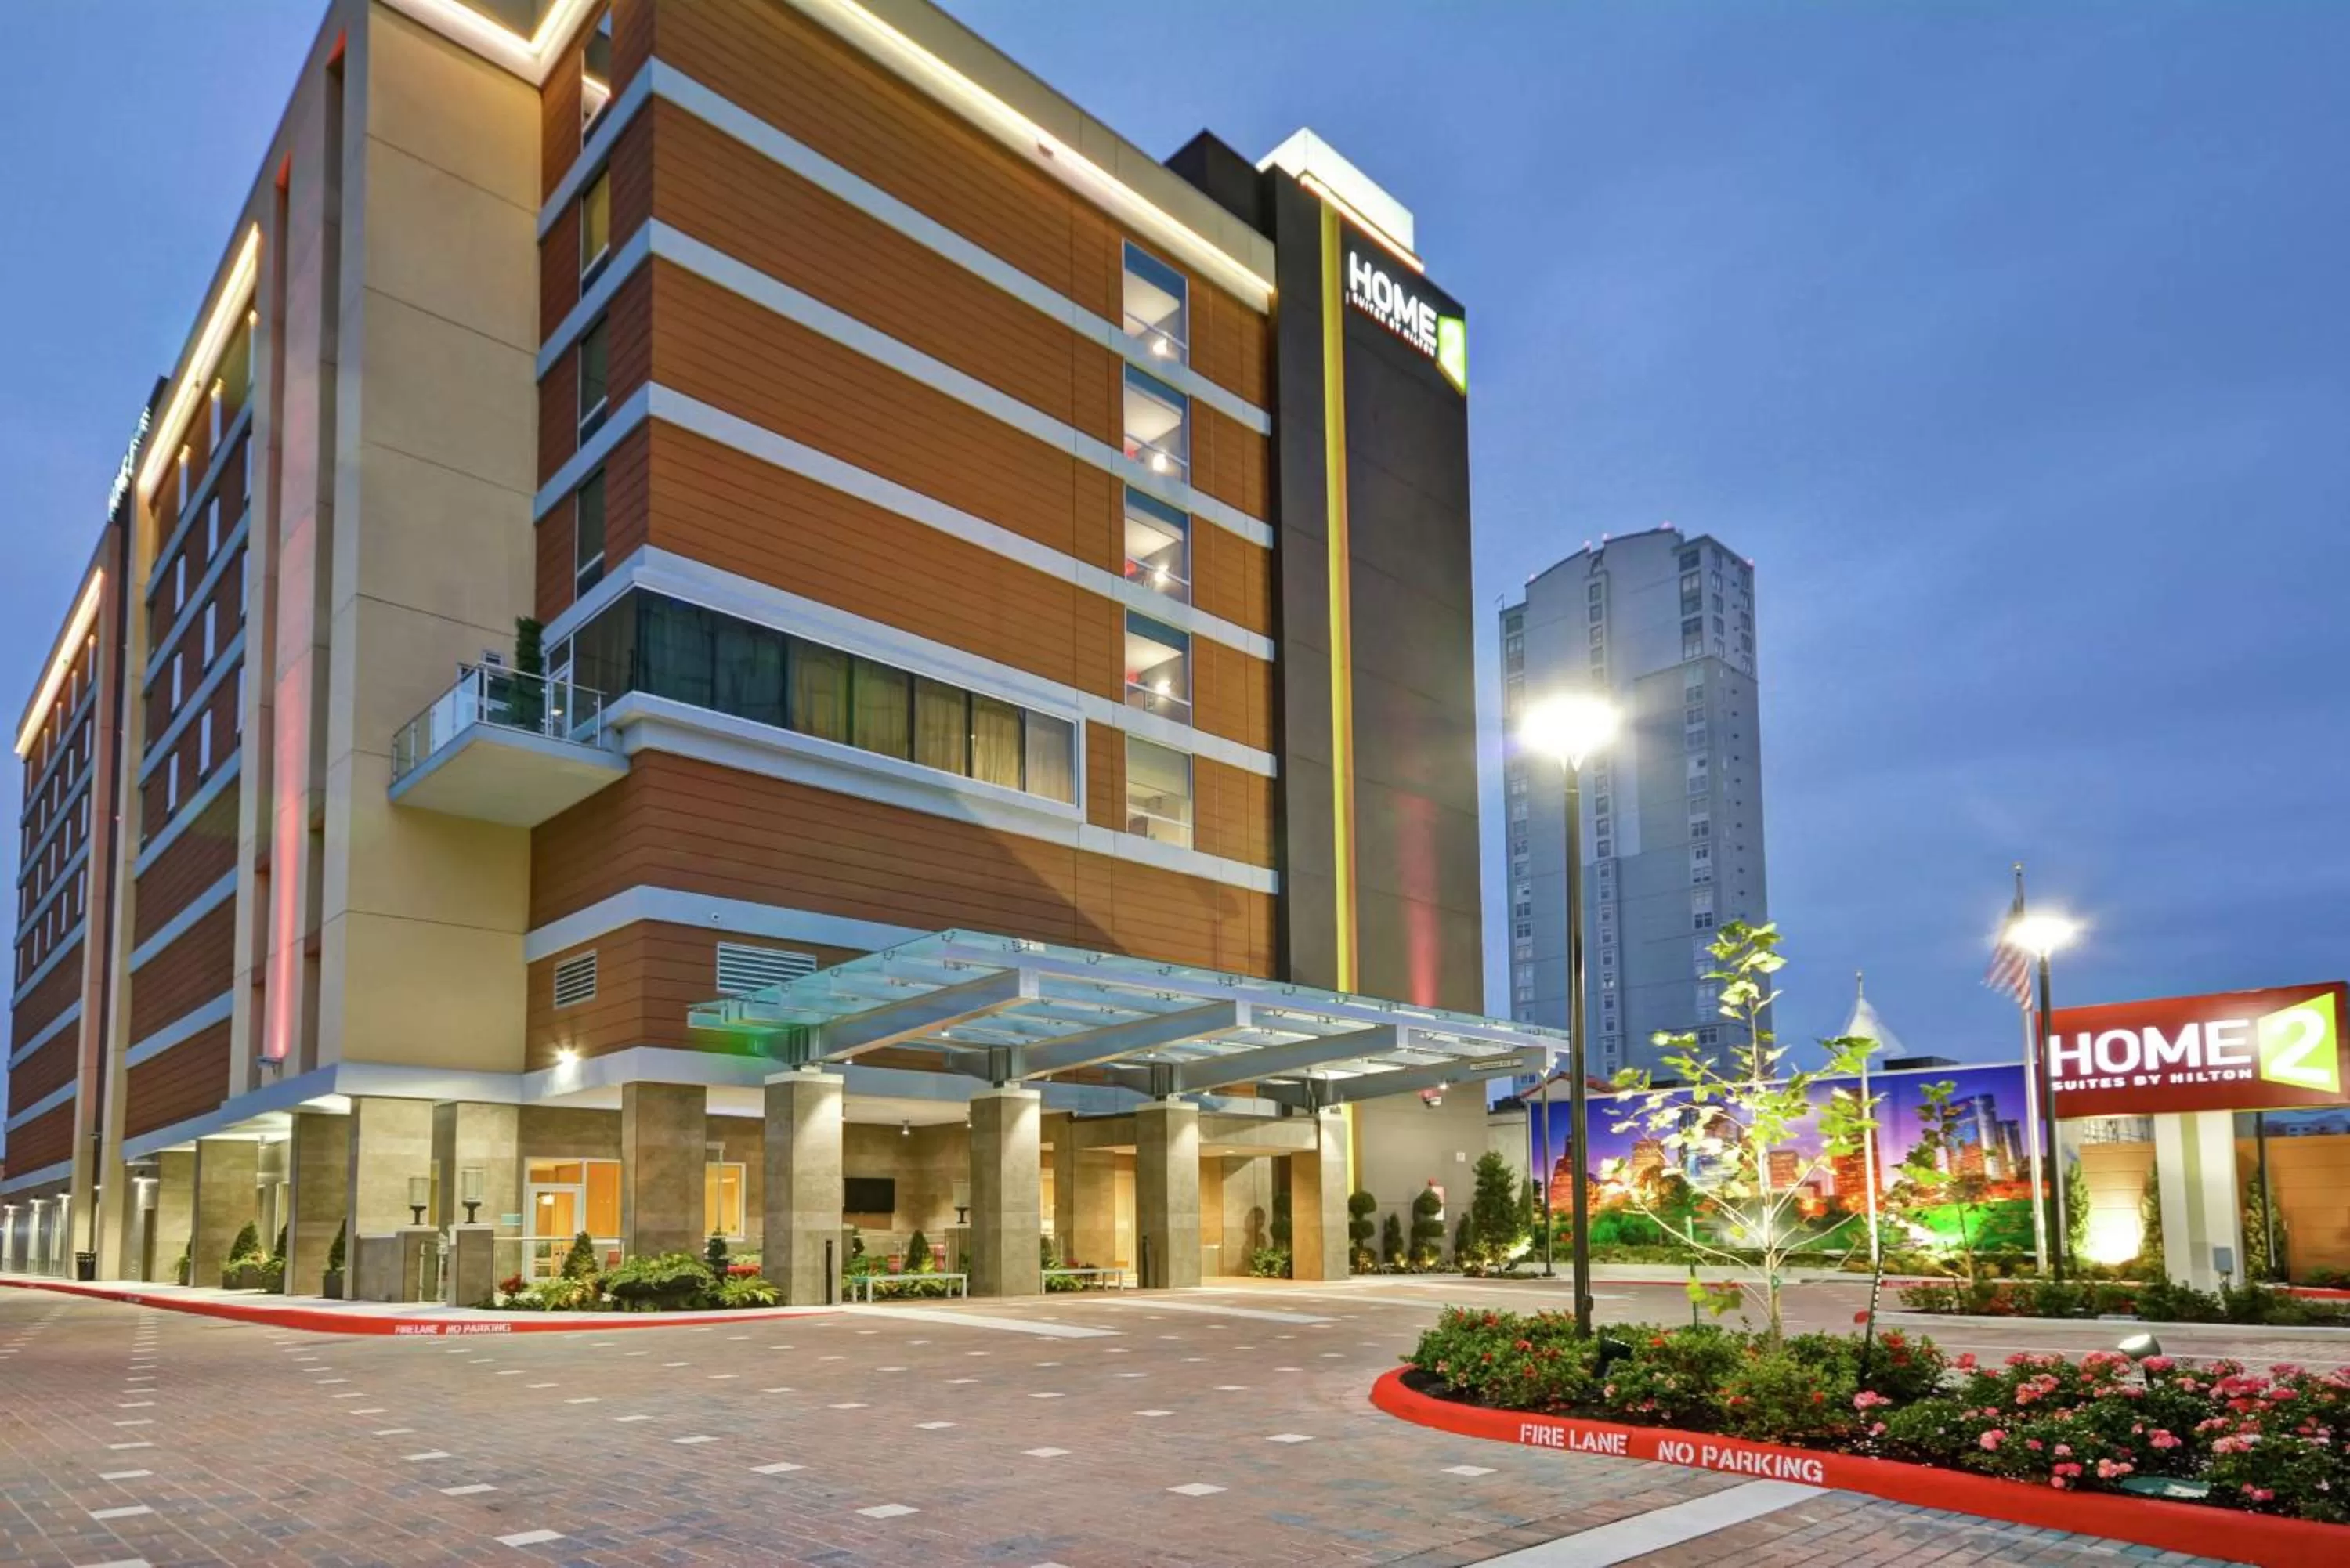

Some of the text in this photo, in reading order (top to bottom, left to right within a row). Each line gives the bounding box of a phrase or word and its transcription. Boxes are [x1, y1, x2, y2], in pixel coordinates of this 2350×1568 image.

[1349, 251, 1437, 347] HOME
[2050, 1009, 2330, 1083] HOME 2
[2052, 1068, 2253, 1091] SUITES BY HILTON
[414, 1324, 439, 1335] LANE
[446, 1325, 461, 1335] NO
[463, 1324, 512, 1335] PARKING
[1520, 1423, 1824, 1483] FIRE LANE NO PARKING
